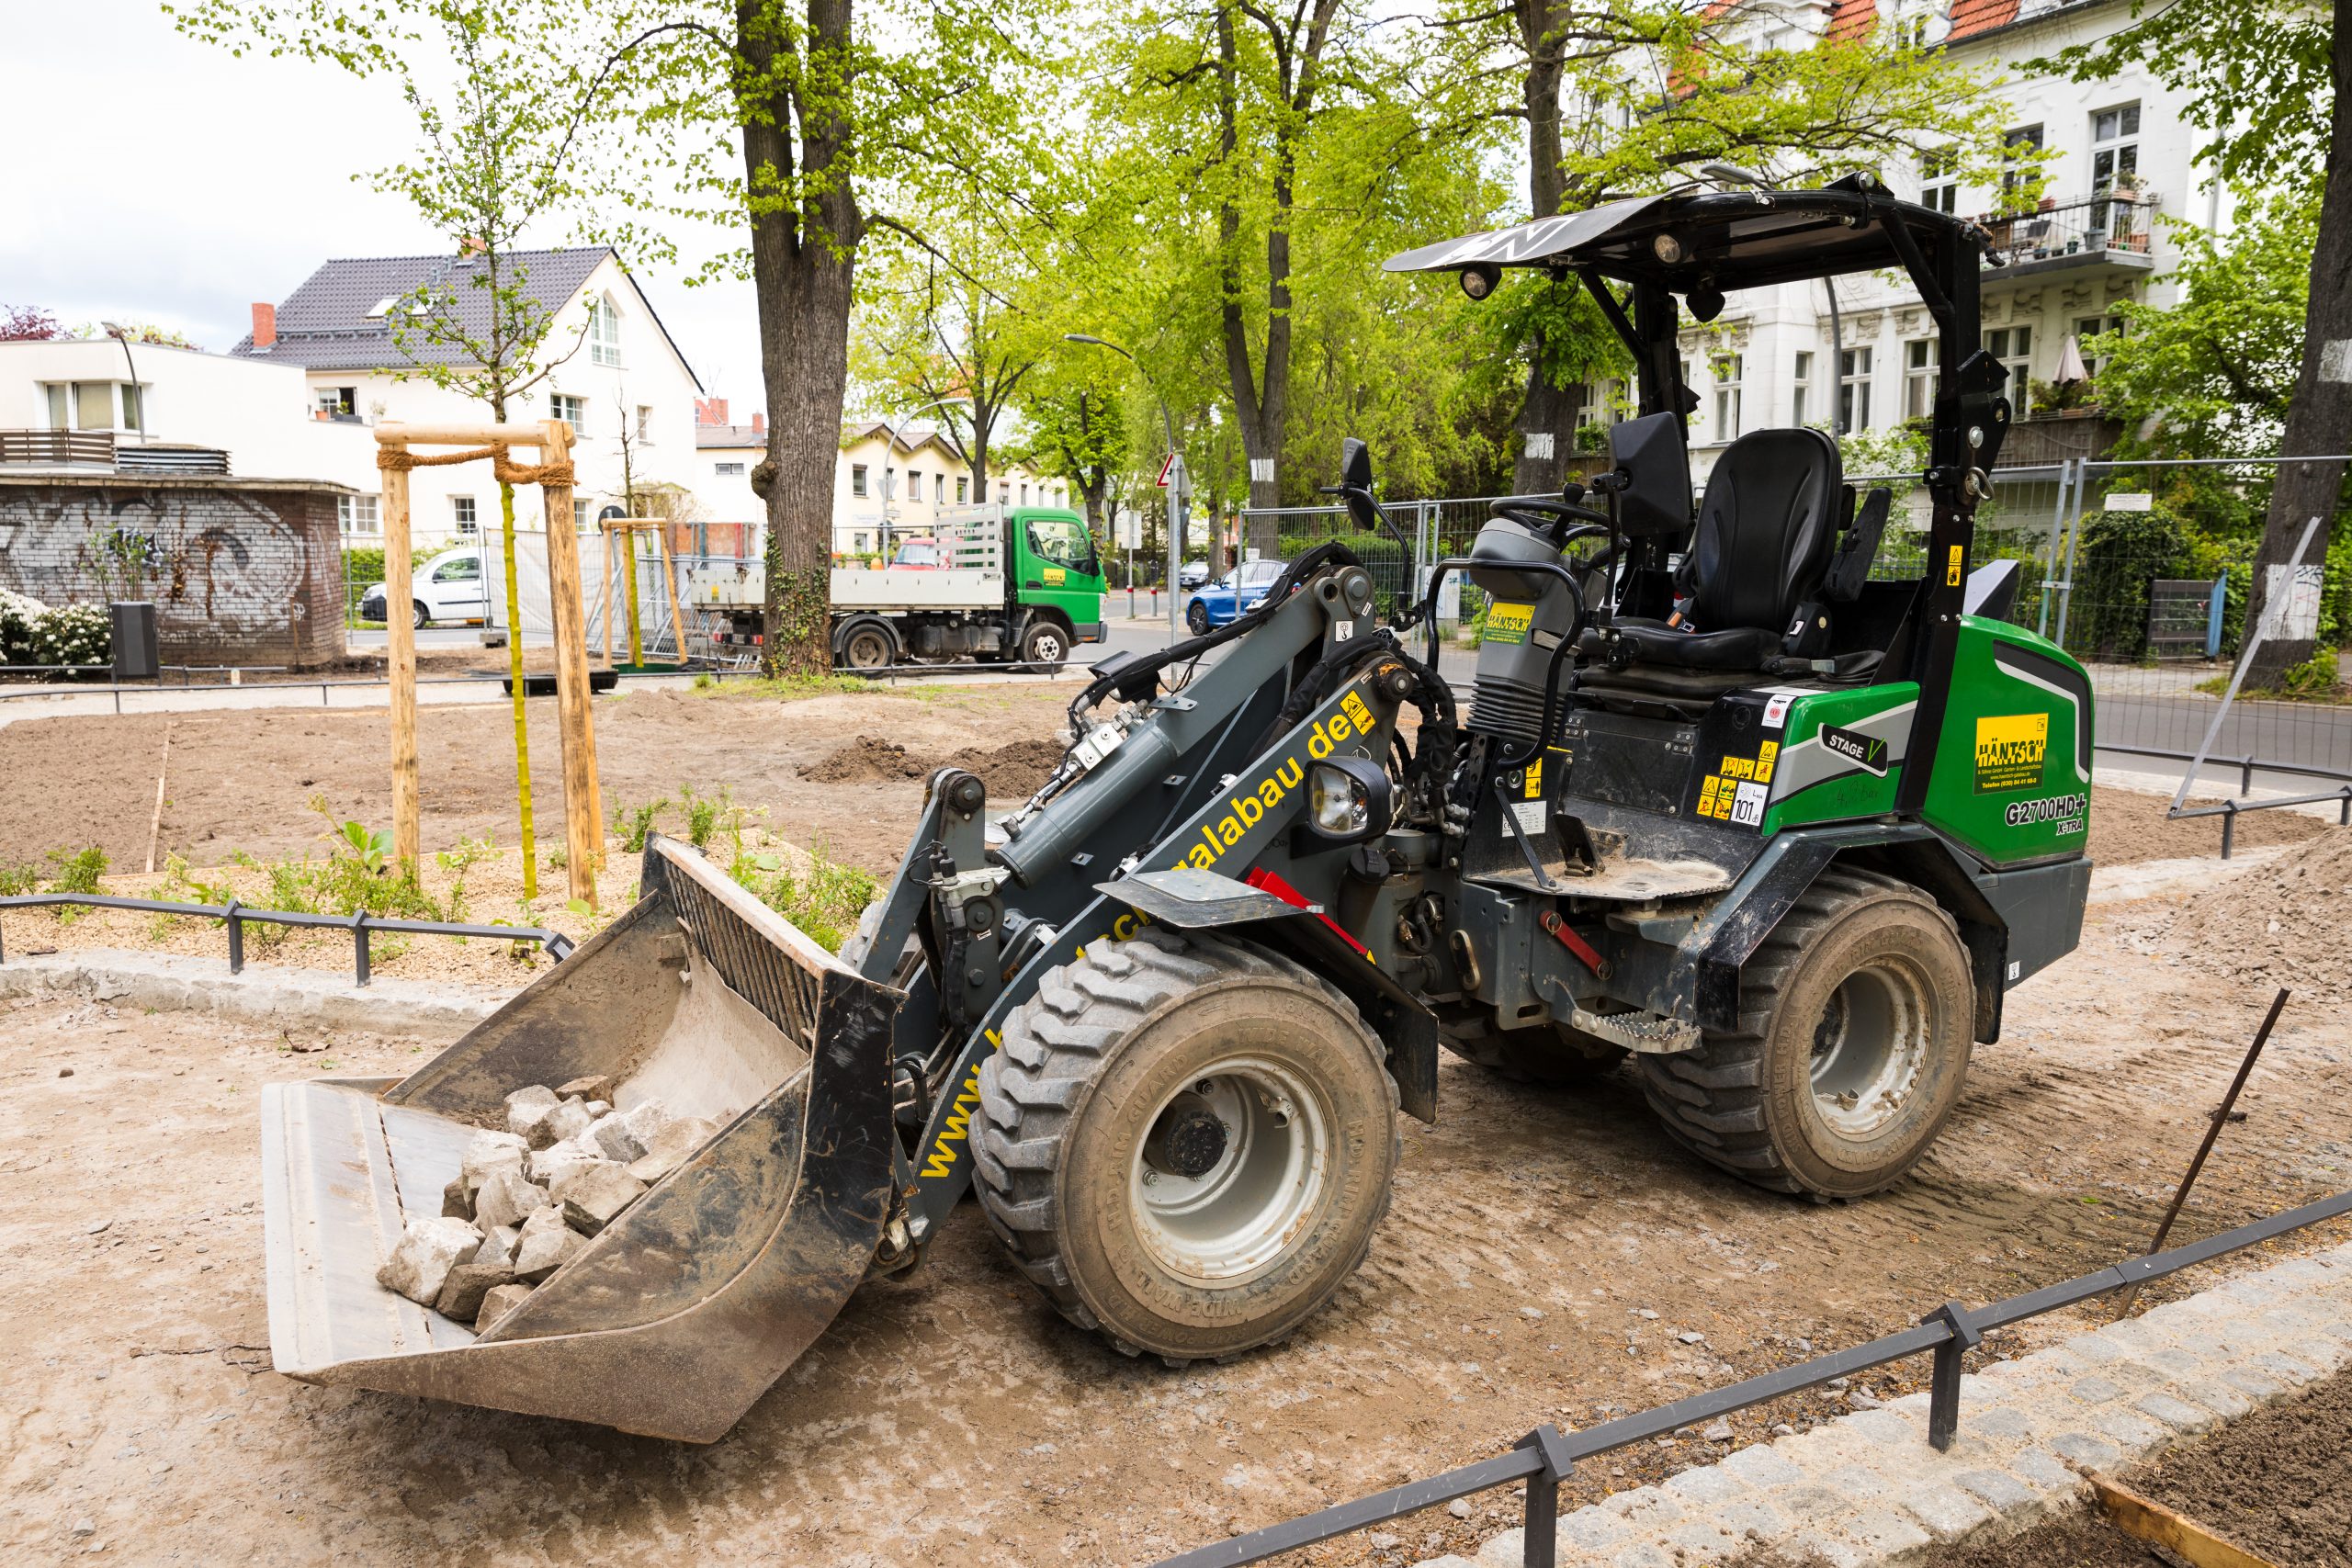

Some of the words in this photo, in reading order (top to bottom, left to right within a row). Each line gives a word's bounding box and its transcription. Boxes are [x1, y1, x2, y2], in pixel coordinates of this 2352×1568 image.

[1829, 735, 1864, 759] STAGE
[1978, 738, 2044, 767] HÄNTSCH
[1170, 756, 1304, 871] alabau
[1736, 799, 1754, 822] 101
[2005, 793, 2086, 826] G2700HD+
[2056, 818, 2084, 836] X-TRA
[1774, 1064, 1790, 1120] POWER
[1108, 1132, 1132, 1175] RIM
[1126, 1054, 1187, 1124] GUARD
[1338, 1169, 1363, 1213] RIM
[1136, 1271, 1182, 1313] WALL
[1191, 1299, 1243, 1318] WIDE
